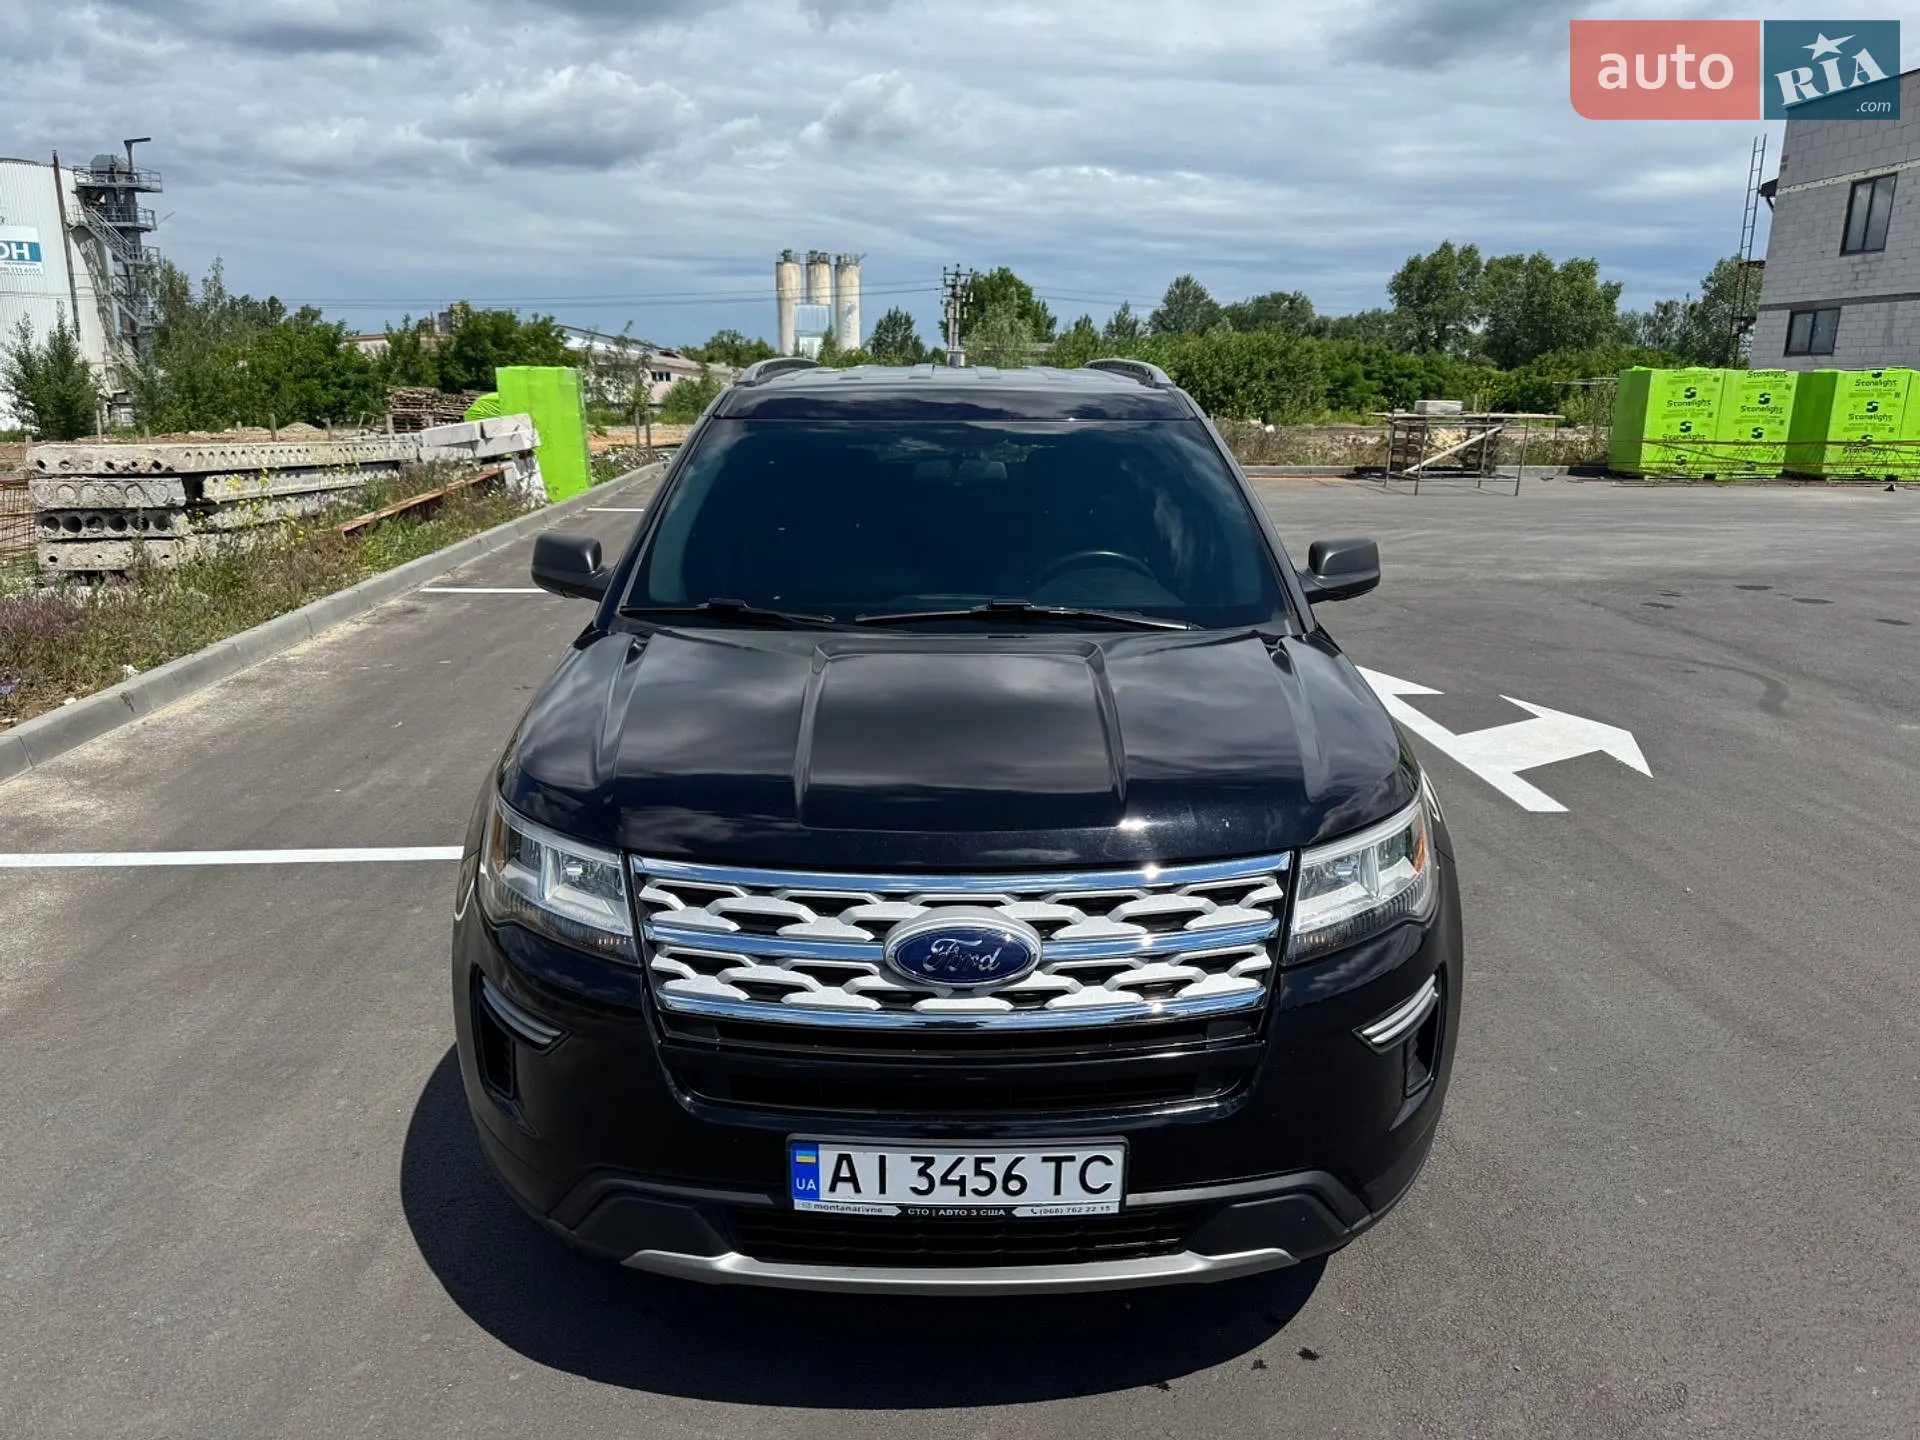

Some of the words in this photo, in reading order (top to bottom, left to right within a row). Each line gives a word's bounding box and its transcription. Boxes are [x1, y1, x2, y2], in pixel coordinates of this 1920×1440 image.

[1855, 378, 1897, 387] Stonelight
[1666, 398, 1712, 408] Stonelight
[1740, 405, 1784, 414] Stonelight
[1848, 413, 1893, 422] Stonelight
[922, 938, 1002, 973] Ford
[828, 1153, 887, 1195] AI
[909, 1155, 1028, 1197] 3456
[1041, 1154, 1114, 1195] TC
[796, 1178, 816, 1191] UA
[907, 1208, 929, 1216] СТО
[938, 1208, 968, 1216] АВТО
